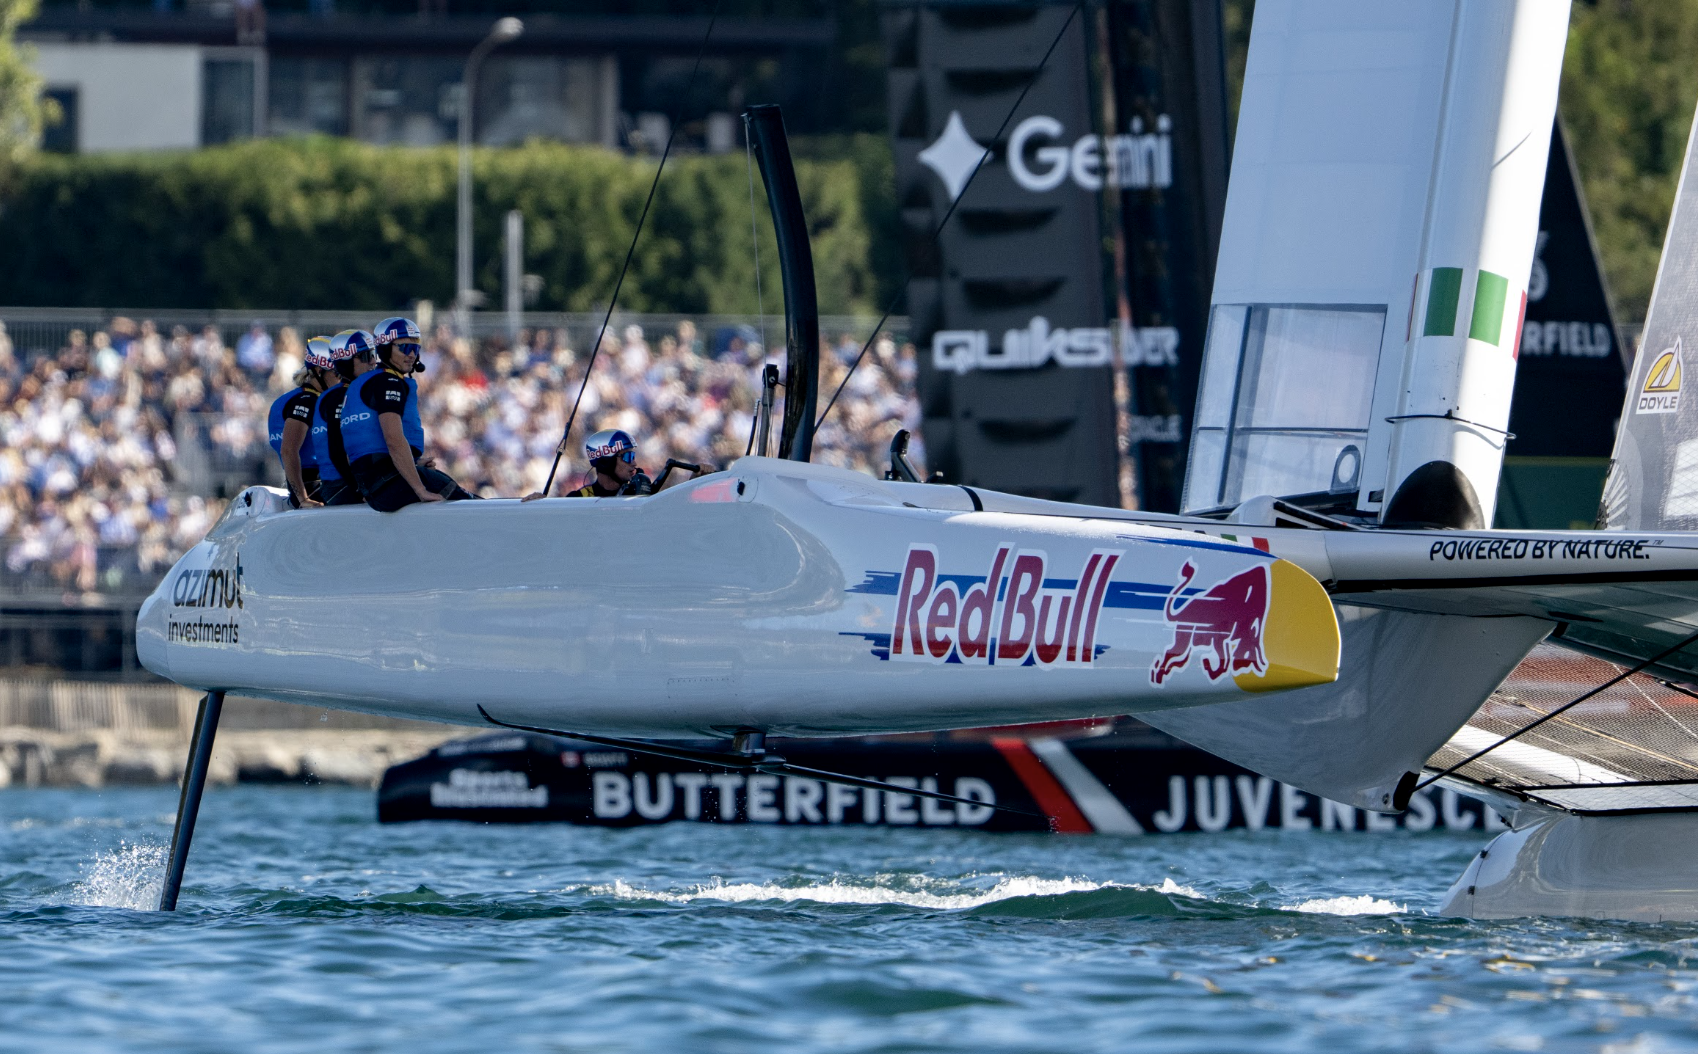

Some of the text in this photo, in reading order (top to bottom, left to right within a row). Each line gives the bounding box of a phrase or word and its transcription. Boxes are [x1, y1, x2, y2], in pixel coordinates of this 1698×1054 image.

[1523, 321, 1612, 357] RFIELD
[319, 355, 335, 369] Bu
[1639, 396, 1678, 410] DOYLE
[602, 440, 624, 456] Bull
[1430, 538, 1529, 560] POWERED
[1531, 539, 1563, 560] BY
[1562, 539, 1650, 560] NATURE.
[173, 552, 244, 609] azimut
[892, 548, 1120, 664] Red Bull
[168, 614, 239, 644] investments
[593, 773, 996, 826] BUTTERFIELD
